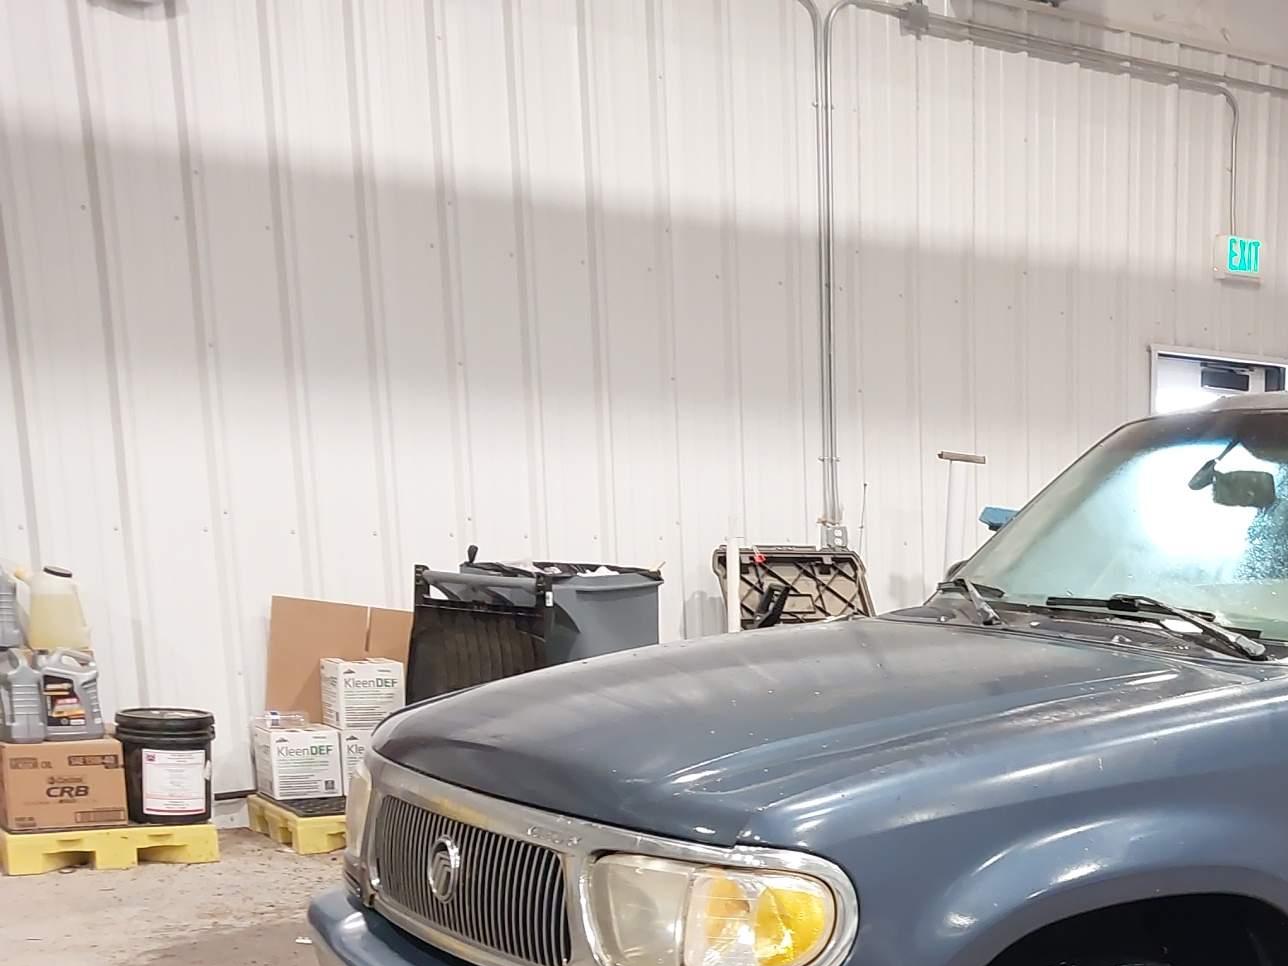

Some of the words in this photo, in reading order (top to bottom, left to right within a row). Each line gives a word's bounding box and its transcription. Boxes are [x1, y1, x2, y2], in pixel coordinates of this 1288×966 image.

[1229, 238, 1260, 273] EXIT
[343, 677, 399, 689] KleenDEF
[276, 744, 334, 757] KleenDEF
[346, 744, 365, 755] Kle
[46, 785, 90, 798] CRB
